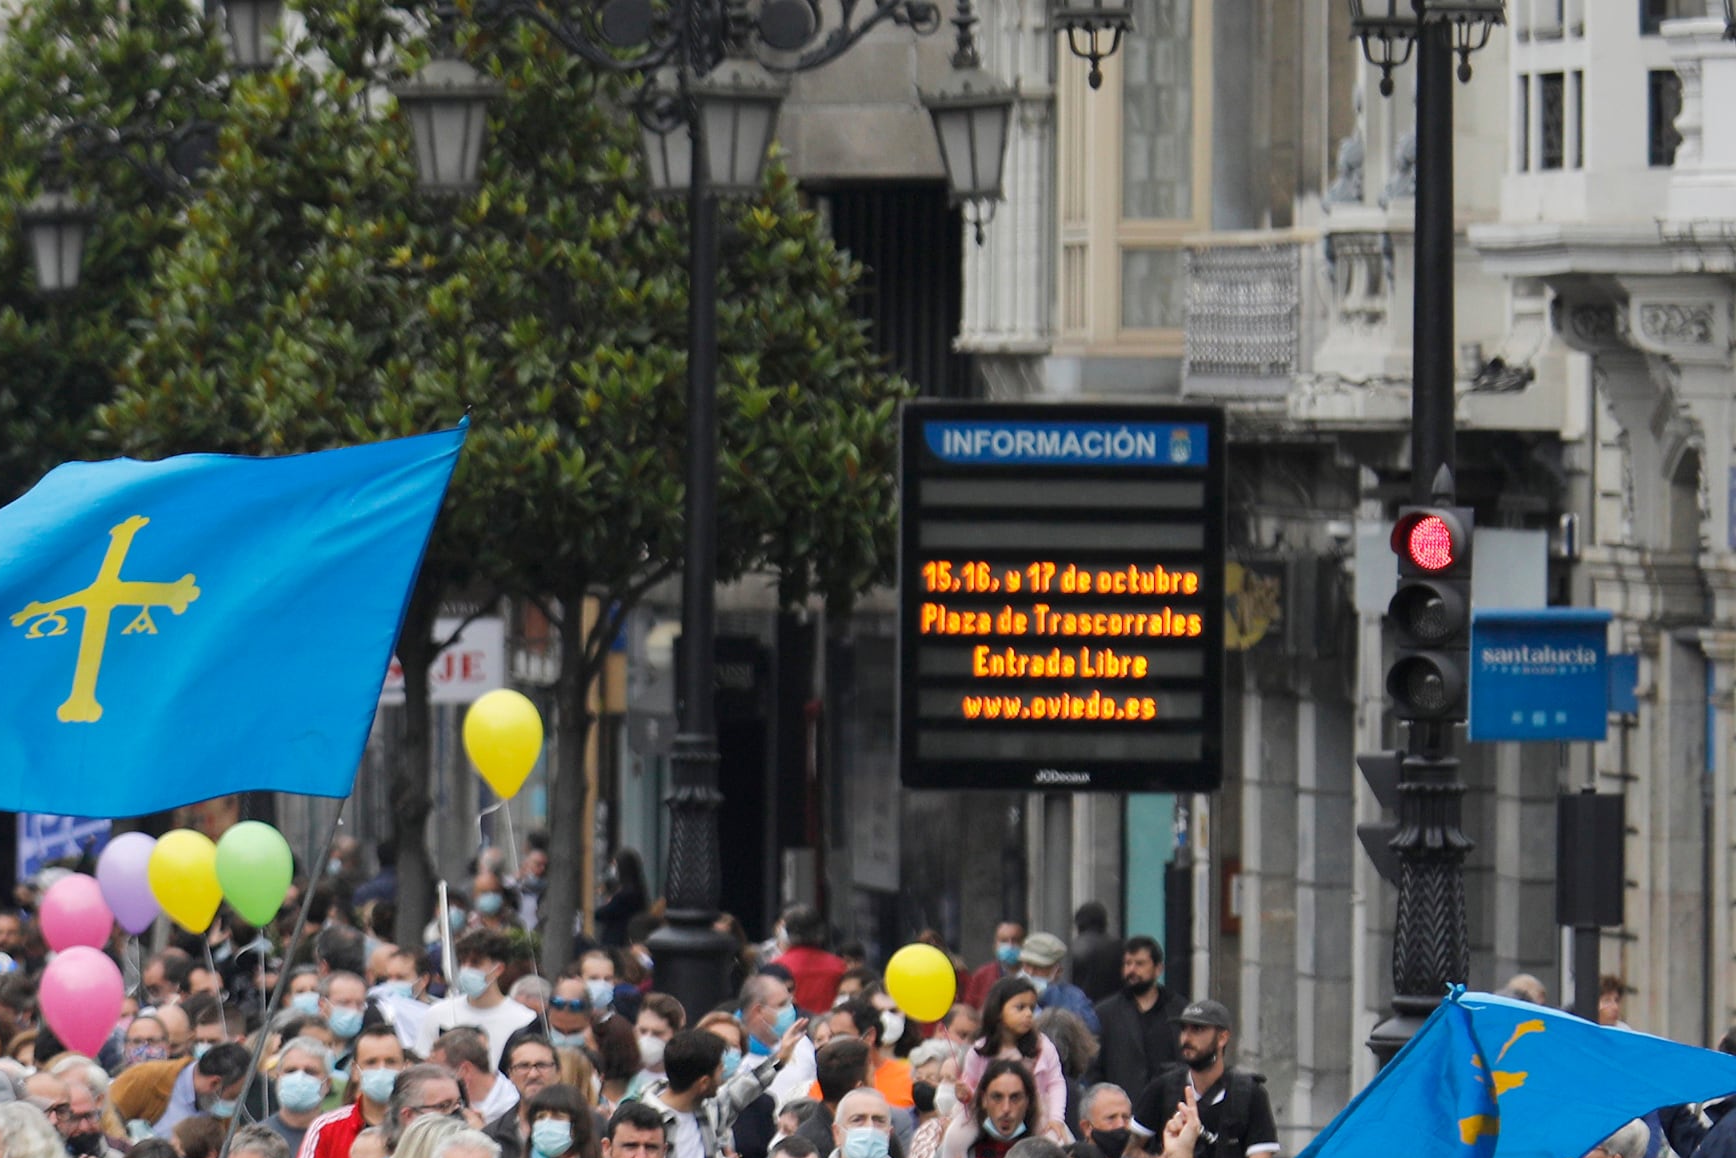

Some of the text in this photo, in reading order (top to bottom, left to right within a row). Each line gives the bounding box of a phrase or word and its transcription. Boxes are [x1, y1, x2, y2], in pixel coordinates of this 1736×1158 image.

[943, 427, 1157, 458] INFORMACIÓN
[1004, 569, 1022, 594] y
[1025, 561, 1057, 593] 17
[1060, 563, 1092, 594] de
[1095, 564, 1199, 595] octubre
[920, 602, 1203, 638] Plaza de Trascorrales
[972, 645, 1148, 679] Entrada Libre
[962, 689, 1157, 721] www.oviedo.es
